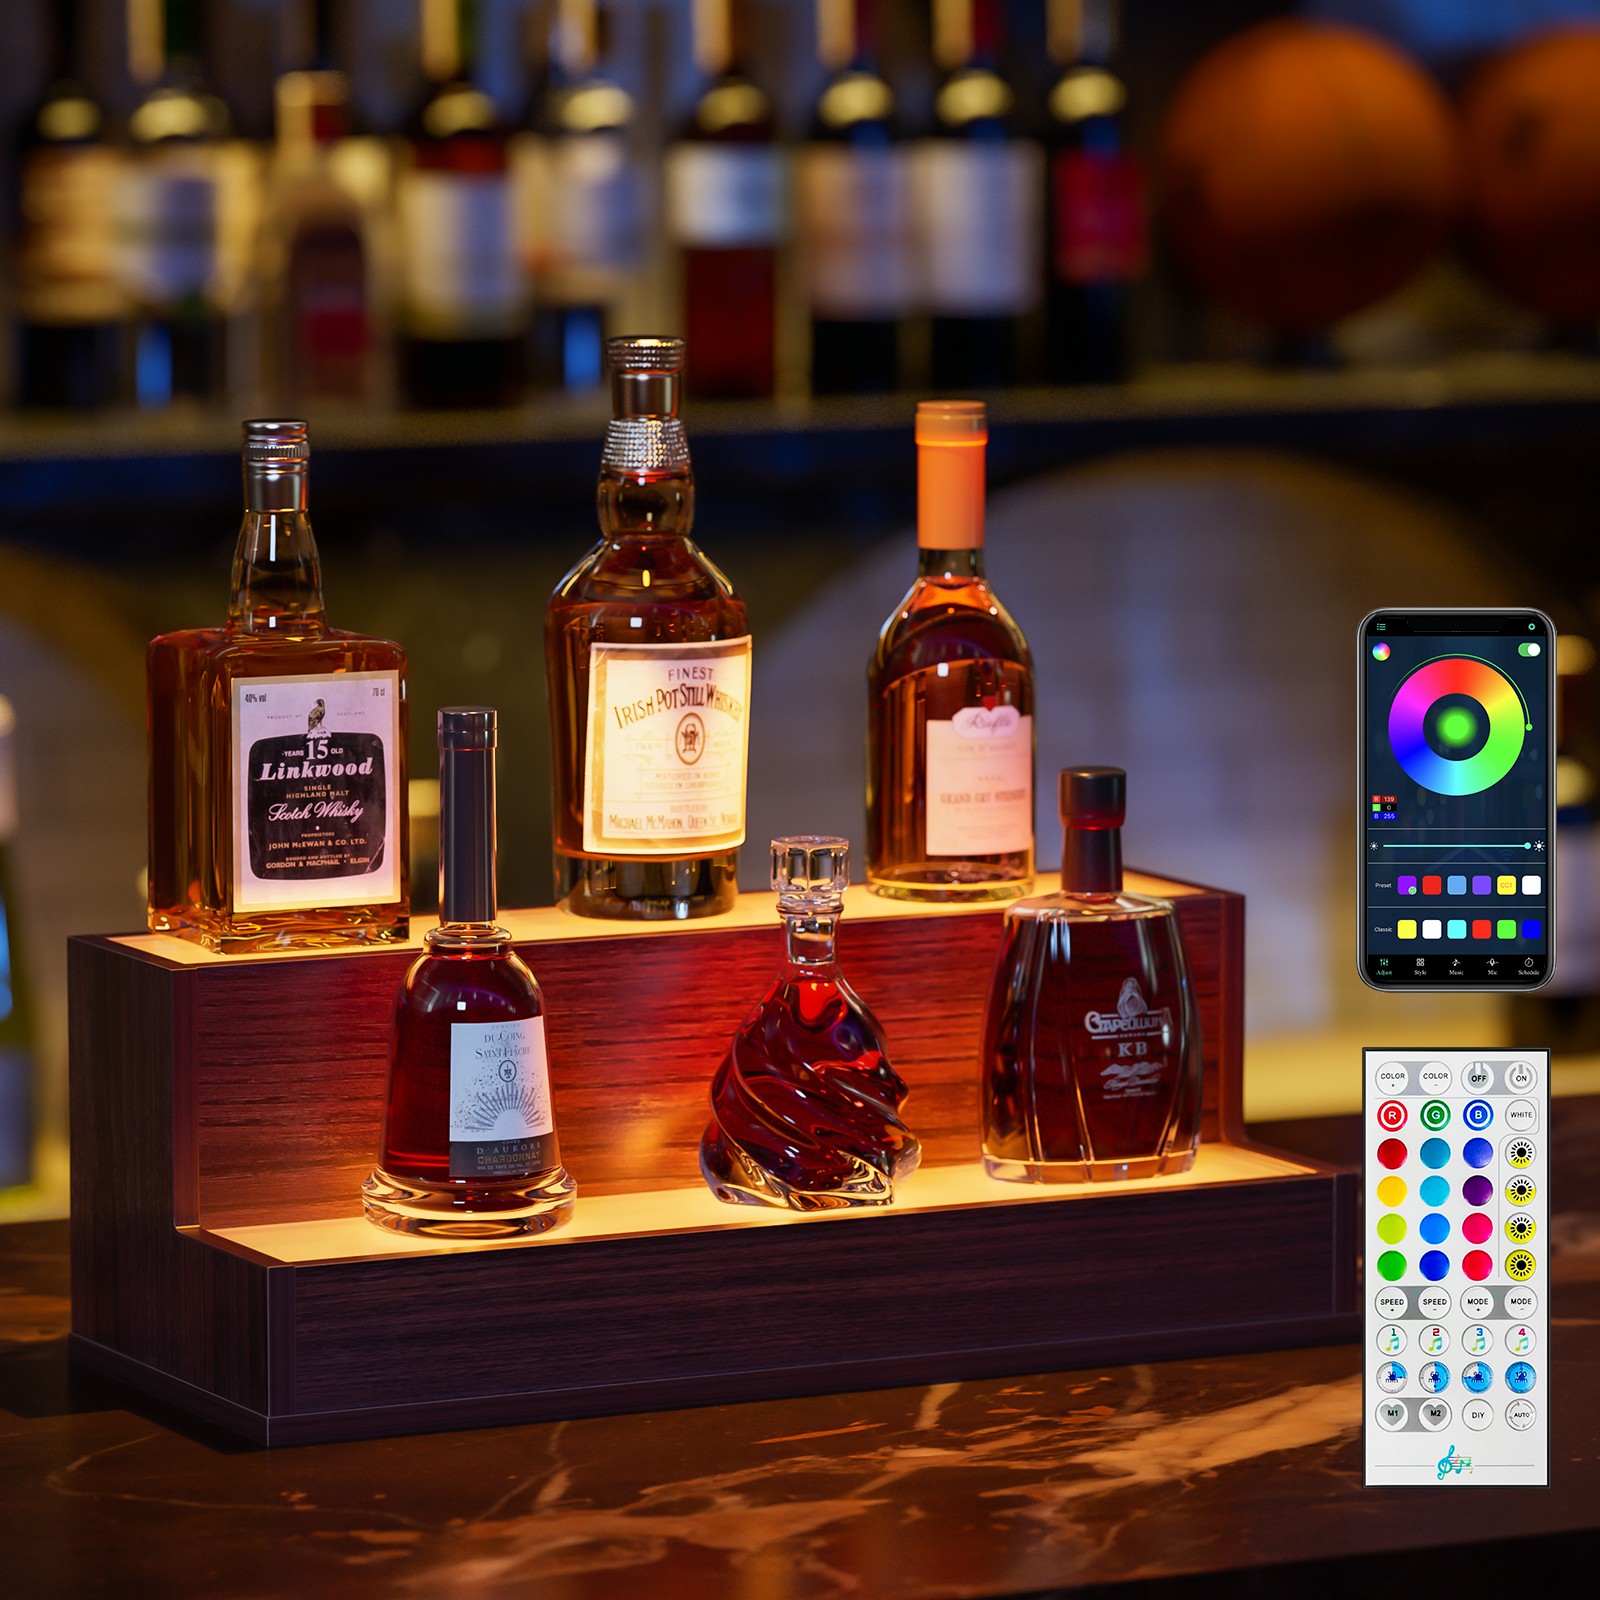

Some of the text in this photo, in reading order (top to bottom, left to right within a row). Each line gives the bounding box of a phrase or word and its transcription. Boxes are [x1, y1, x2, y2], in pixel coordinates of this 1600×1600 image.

[669, 667, 713, 681] FINEST
[372, 688, 385, 697] 70 cl
[245, 693, 257, 703] 40%
[614, 696, 654, 728] IRISH
[656, 689, 679, 713] POT
[680, 683, 704, 707] STILL
[306, 740, 328, 760] 15
[331, 747, 343, 755] OLD
[259, 758, 373, 781] Linkwood
[286, 790, 350, 799] HIGHLAND MALT
[268, 800, 364, 823] Scotch Whisky
[269, 842, 289, 850] JOHN
[266, 861, 296, 869] GORDON
[1388, 1111, 1396, 1120] R
[1432, 1111, 1440, 1119] G
[1475, 1111, 1483, 1119] B
[477, 1150, 540, 1164] CHARDONNAY
[1391, 1328, 1396, 1336] 1
[1433, 1328, 1440, 1336] 2
[1476, 1328, 1483, 1336] 3
[1518, 1328, 1526, 1336] 4
